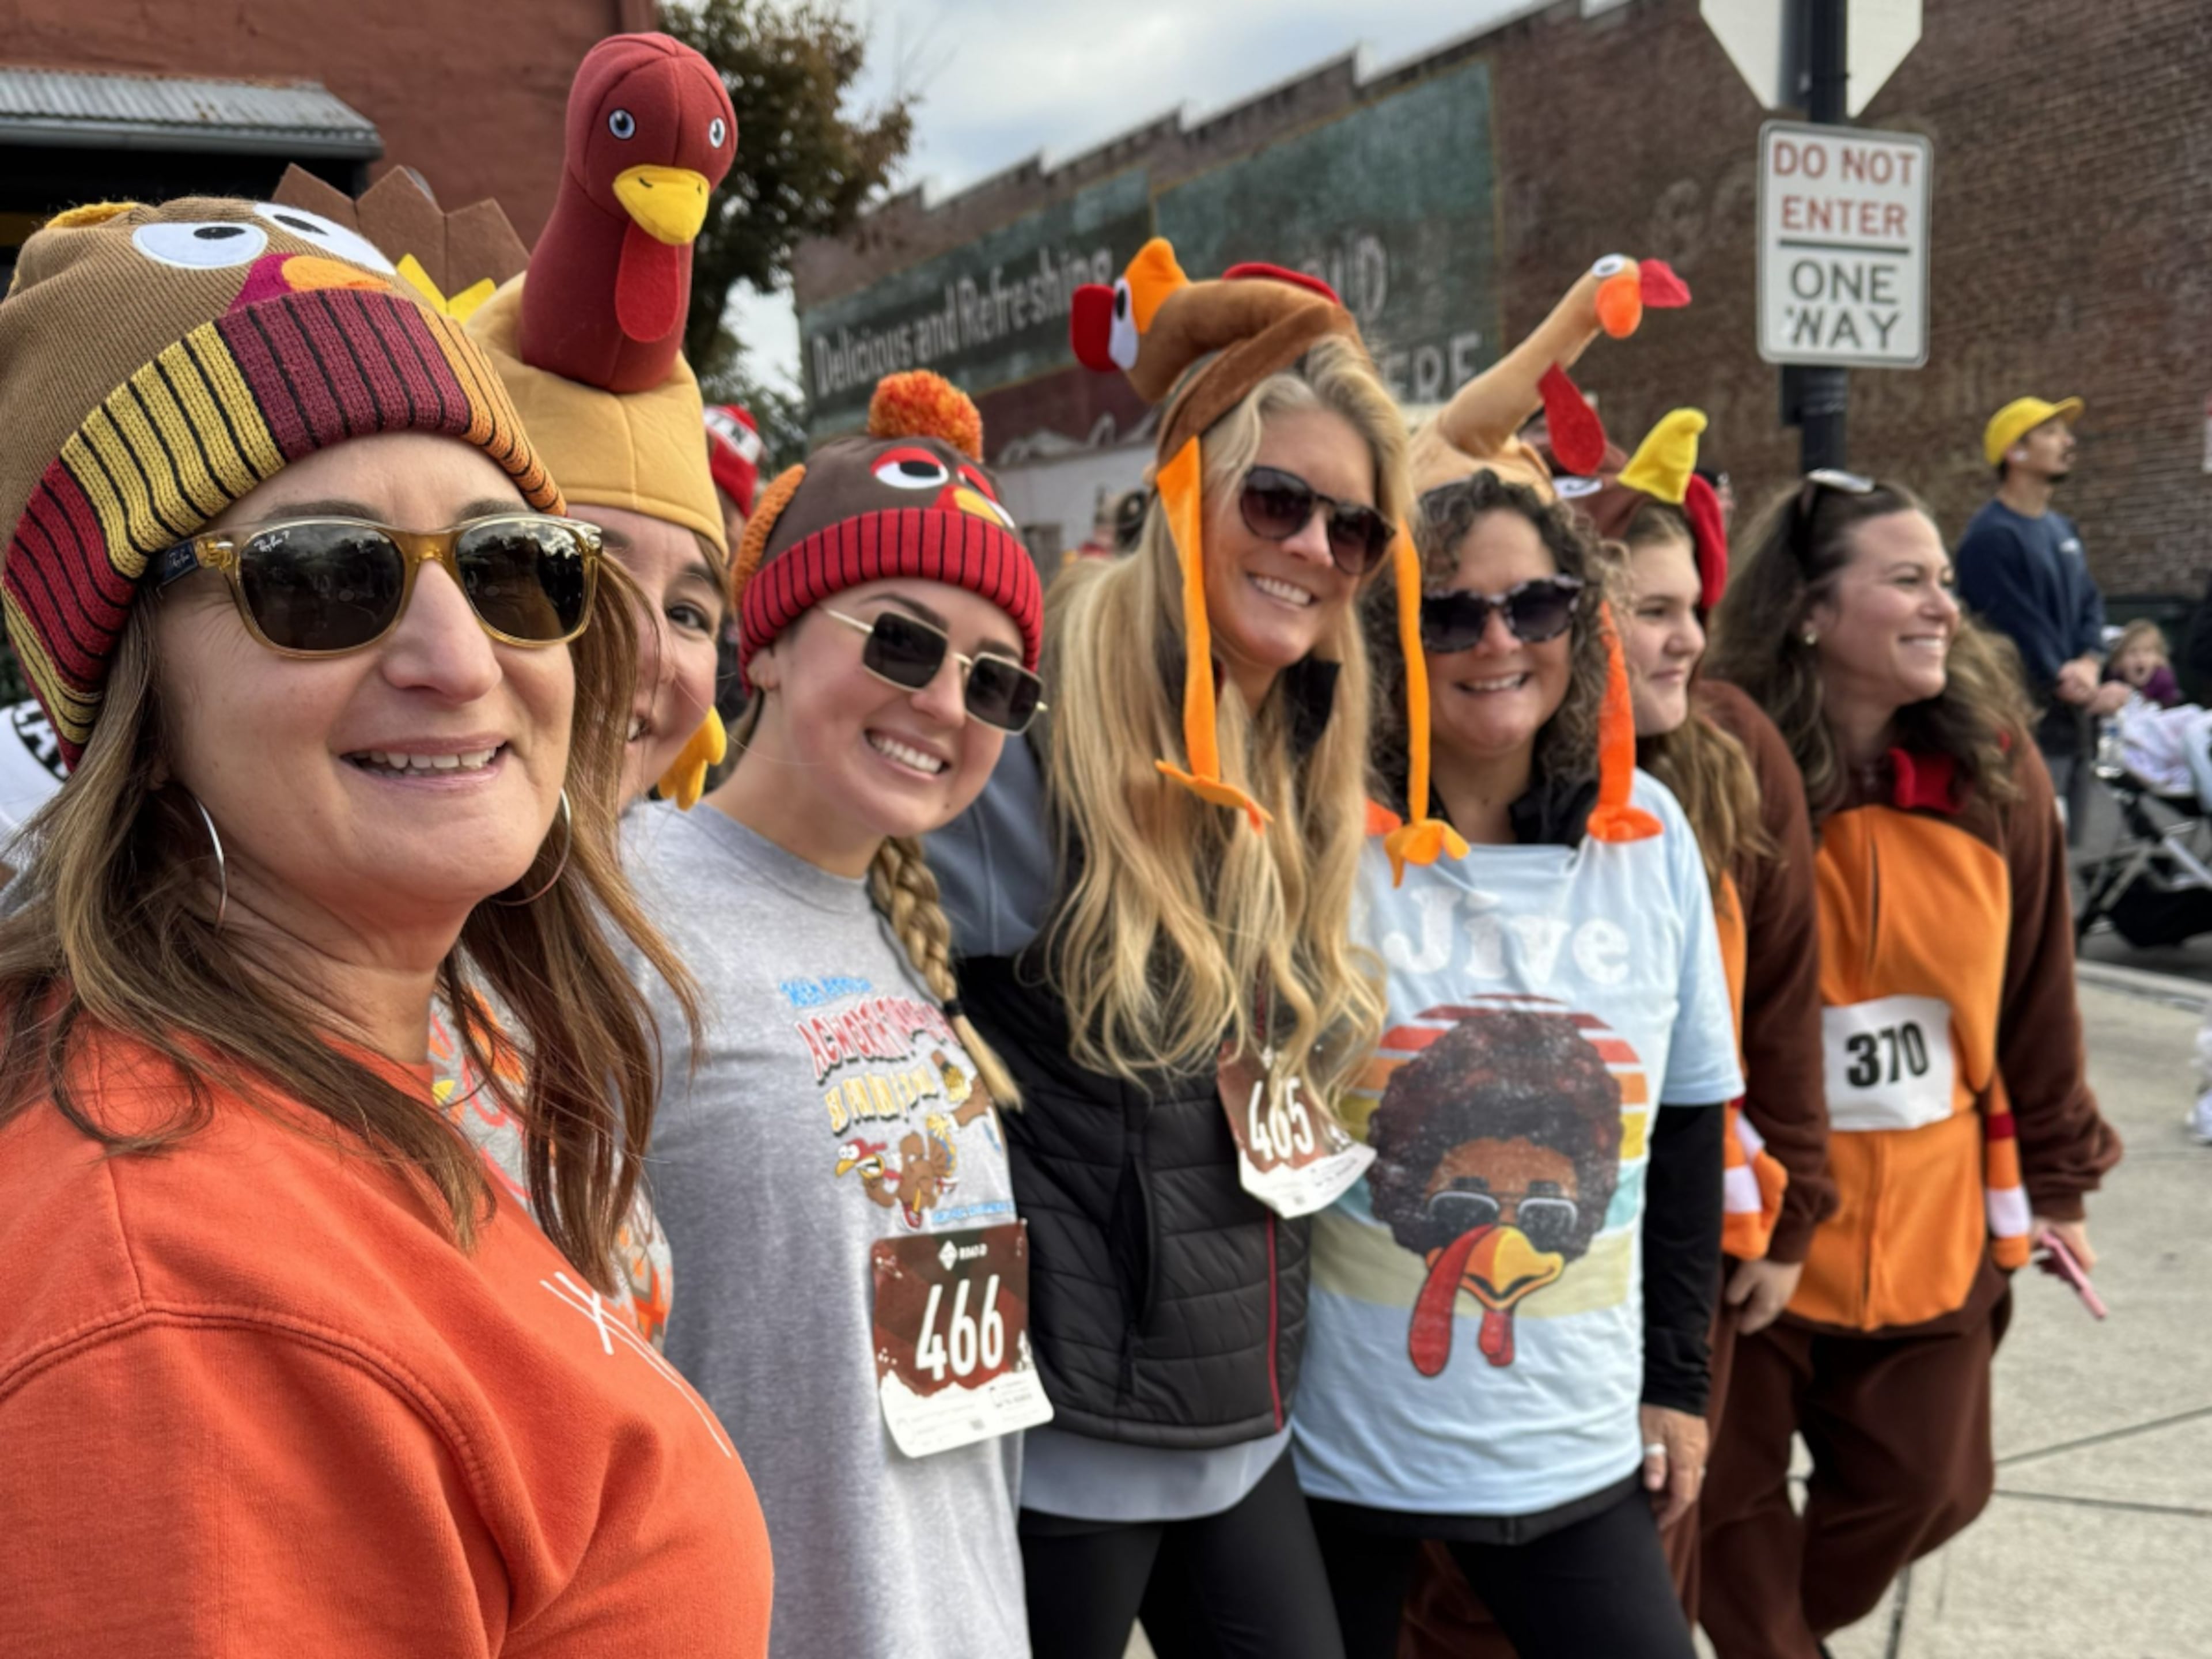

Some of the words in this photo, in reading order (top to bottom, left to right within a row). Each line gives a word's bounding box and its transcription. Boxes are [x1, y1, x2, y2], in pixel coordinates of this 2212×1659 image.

[1772, 140, 1828, 179] DO
[1841, 146, 1915, 185] NOT
[1781, 195, 1908, 237] ENTER
[1790, 259, 1899, 304] ONE
[812, 324, 913, 397] Delicious
[914, 283, 959, 363] and
[1785, 304, 1900, 349] WAY
[1383, 886, 1631, 985] Jive
[1845, 1019, 1929, 1088] 370
[1248, 1075, 1315, 1162] 465
[915, 1274, 1004, 1381] 466
